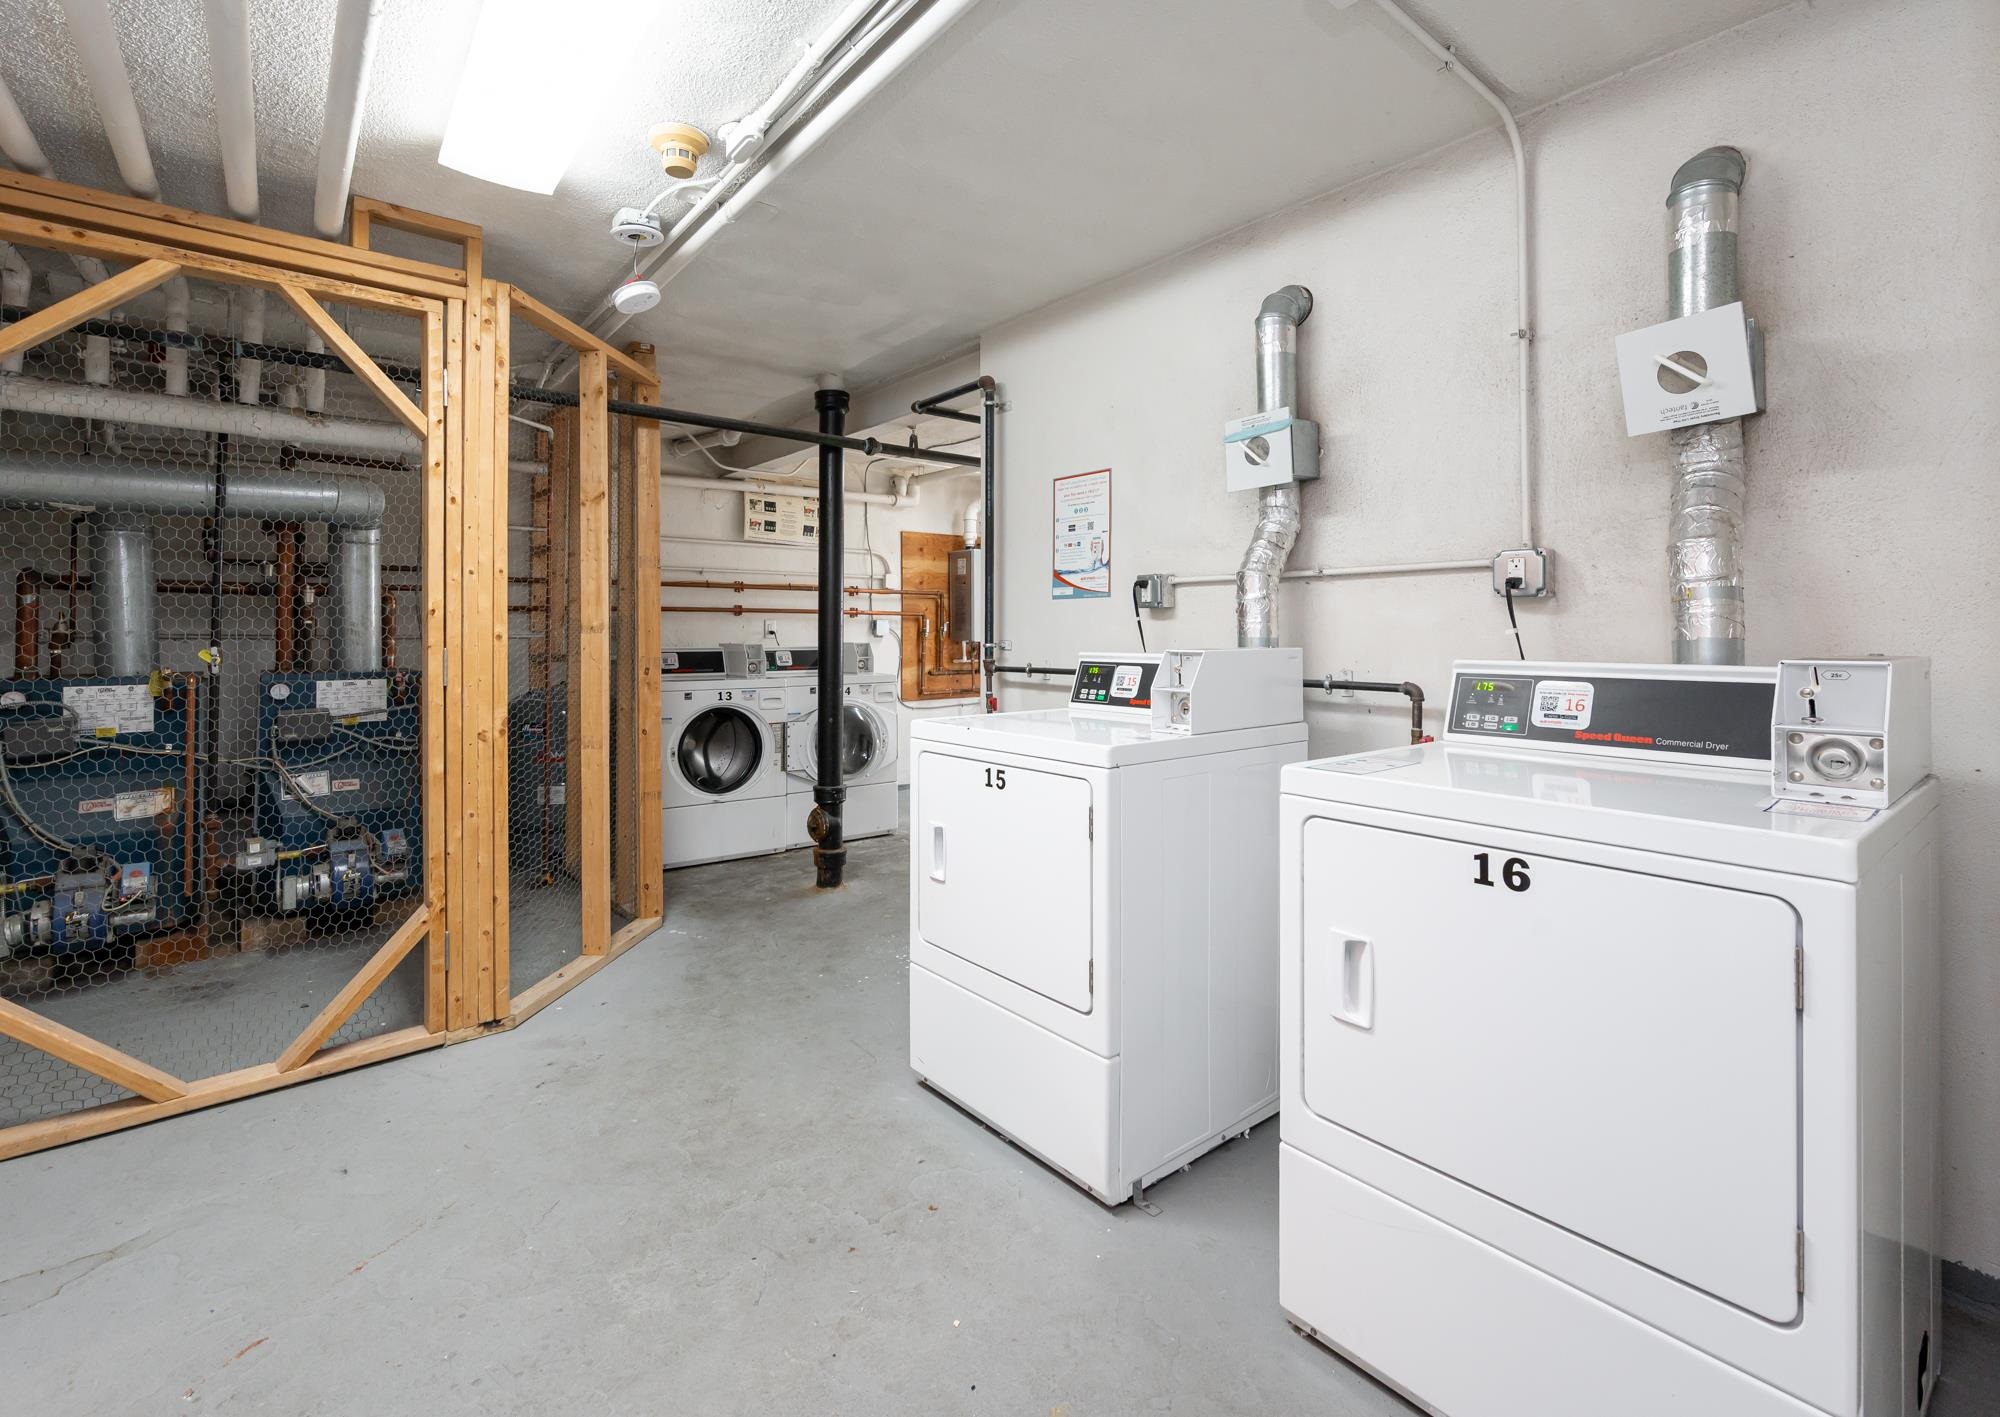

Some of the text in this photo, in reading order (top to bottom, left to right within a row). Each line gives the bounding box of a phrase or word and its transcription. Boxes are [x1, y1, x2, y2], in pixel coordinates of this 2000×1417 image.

[1660, 405, 1687, 415] fantech
[1127, 675, 1137, 687] 15
[717, 691, 733, 701] 13
[844, 687, 851, 696] 4
[1566, 698, 1585, 712] 16
[1574, 730, 1729, 751] Speed Queen Commercial Dryer
[985, 768, 1006, 790] 15
[1474, 853, 1531, 891] 16
